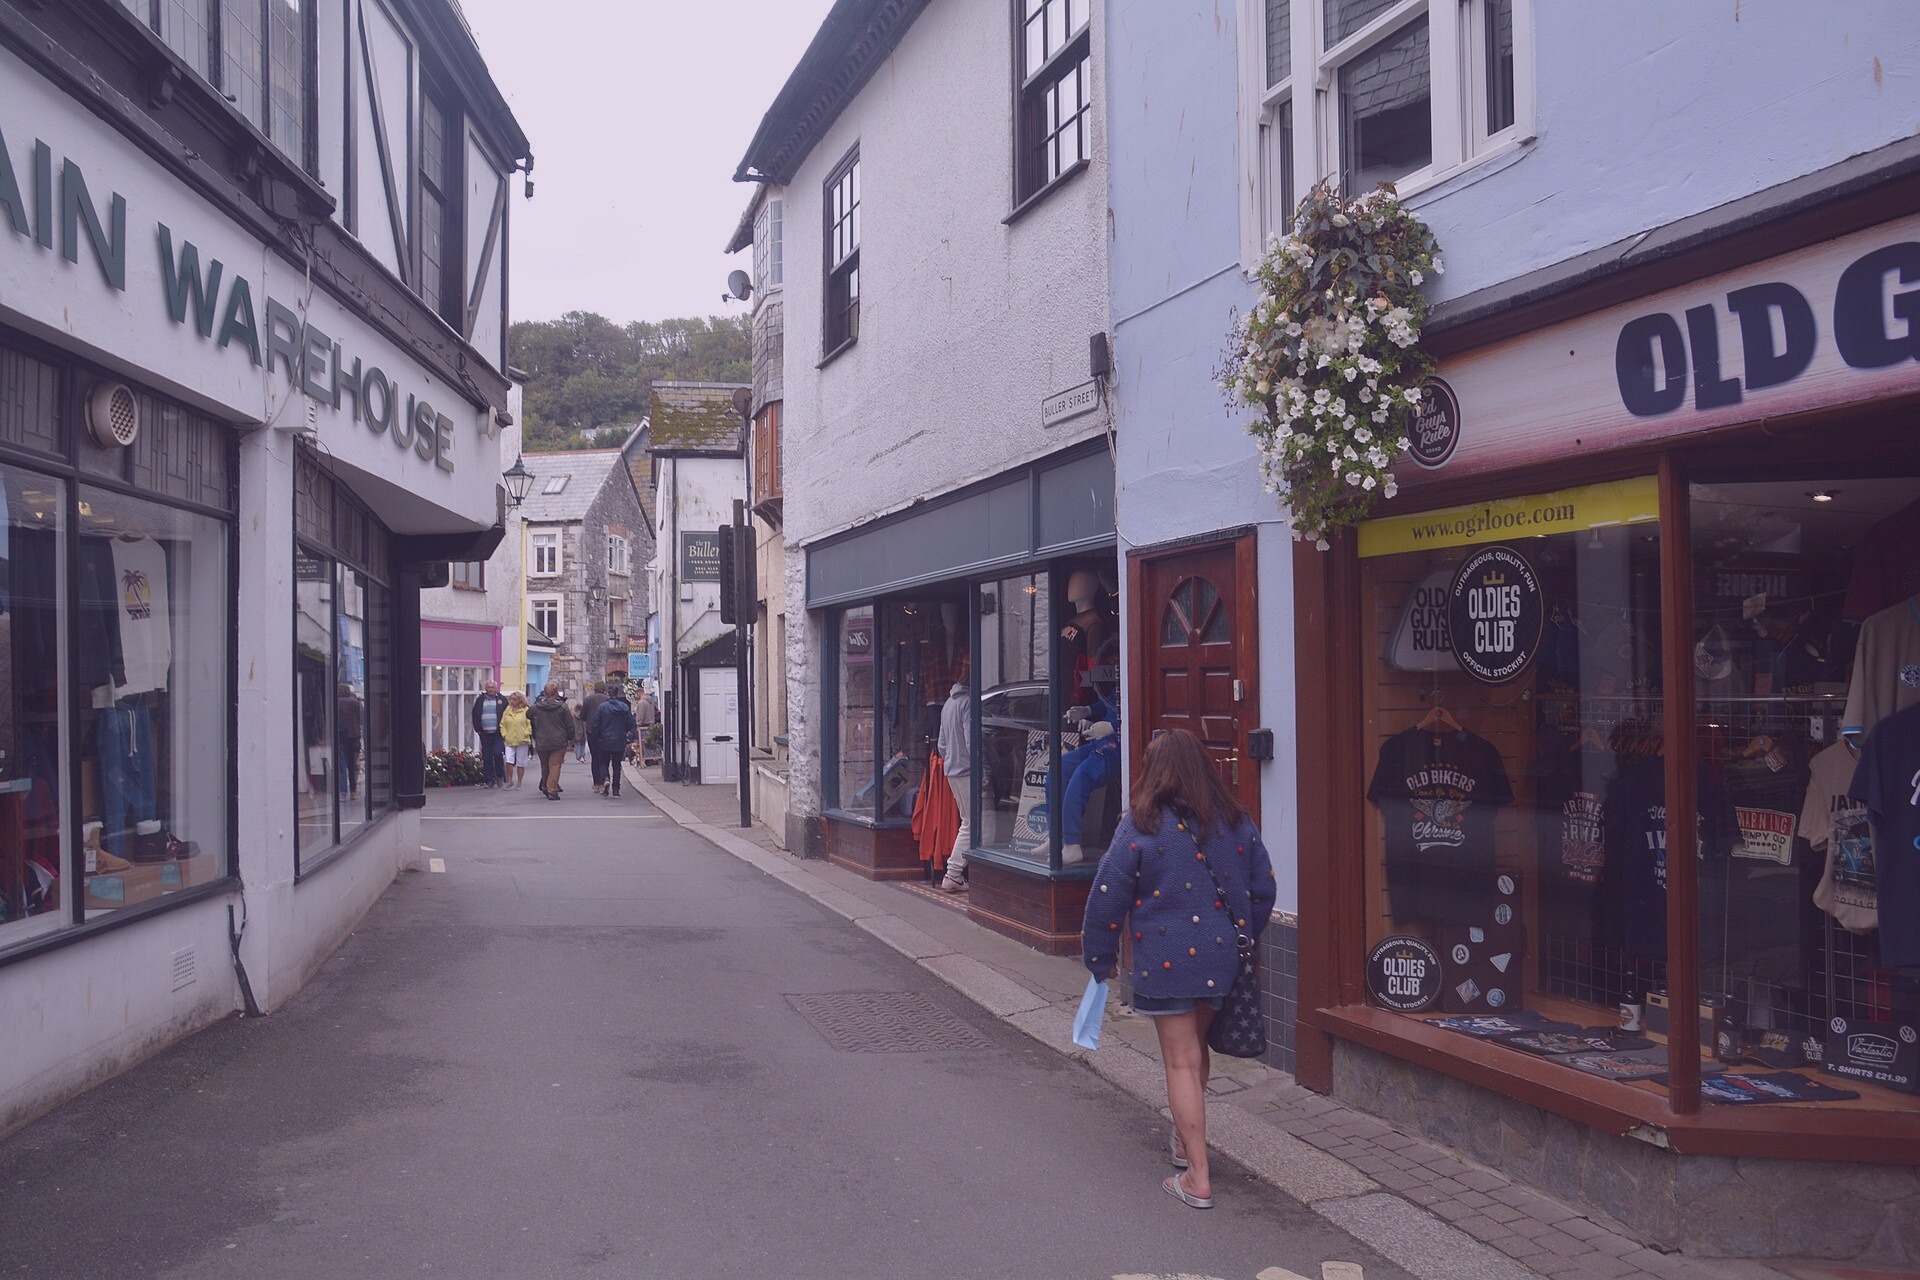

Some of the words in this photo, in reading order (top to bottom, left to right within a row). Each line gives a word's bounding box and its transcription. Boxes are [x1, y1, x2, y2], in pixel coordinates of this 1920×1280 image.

[157, 220, 456, 475] WAREHOUSE
[1615, 281, 1818, 417] OLD
[1044, 400, 1067, 419] BULLER
[1068, 389, 1095, 409] STREET
[1415, 410, 1447, 434] Guys
[1420, 425, 1451, 449] Rule
[1425, 446, 1442, 454] BRAND
[1411, 503, 1576, 539] www.ogrlooe.com
[1523, 571, 1536, 593] FUN
[1415, 587, 1447, 608] OLD
[1468, 584, 1521, 620] OLDIES
[1474, 619, 1515, 654] CLUB
[1462, 651, 1492, 678] OFFICIAL
[1492, 650, 1527, 678] STOCKIST
[1406, 771, 1429, 791] OLD
[1430, 769, 1476, 792] BIKERS
[1383, 957, 1426, 978] OLDIES
[1387, 976, 1421, 996] CLUB
[1378, 992, 1402, 1009] OFFICIAL
[1402, 995, 1429, 1009] STOCKIST
[1805, 1051, 1823, 1062] CLUB
[1851, 1036, 1895, 1058] Vantastic
[1838, 1064, 1874, 1079] SHIRTS
[1874, 1071, 1909, 1085] £21.99
